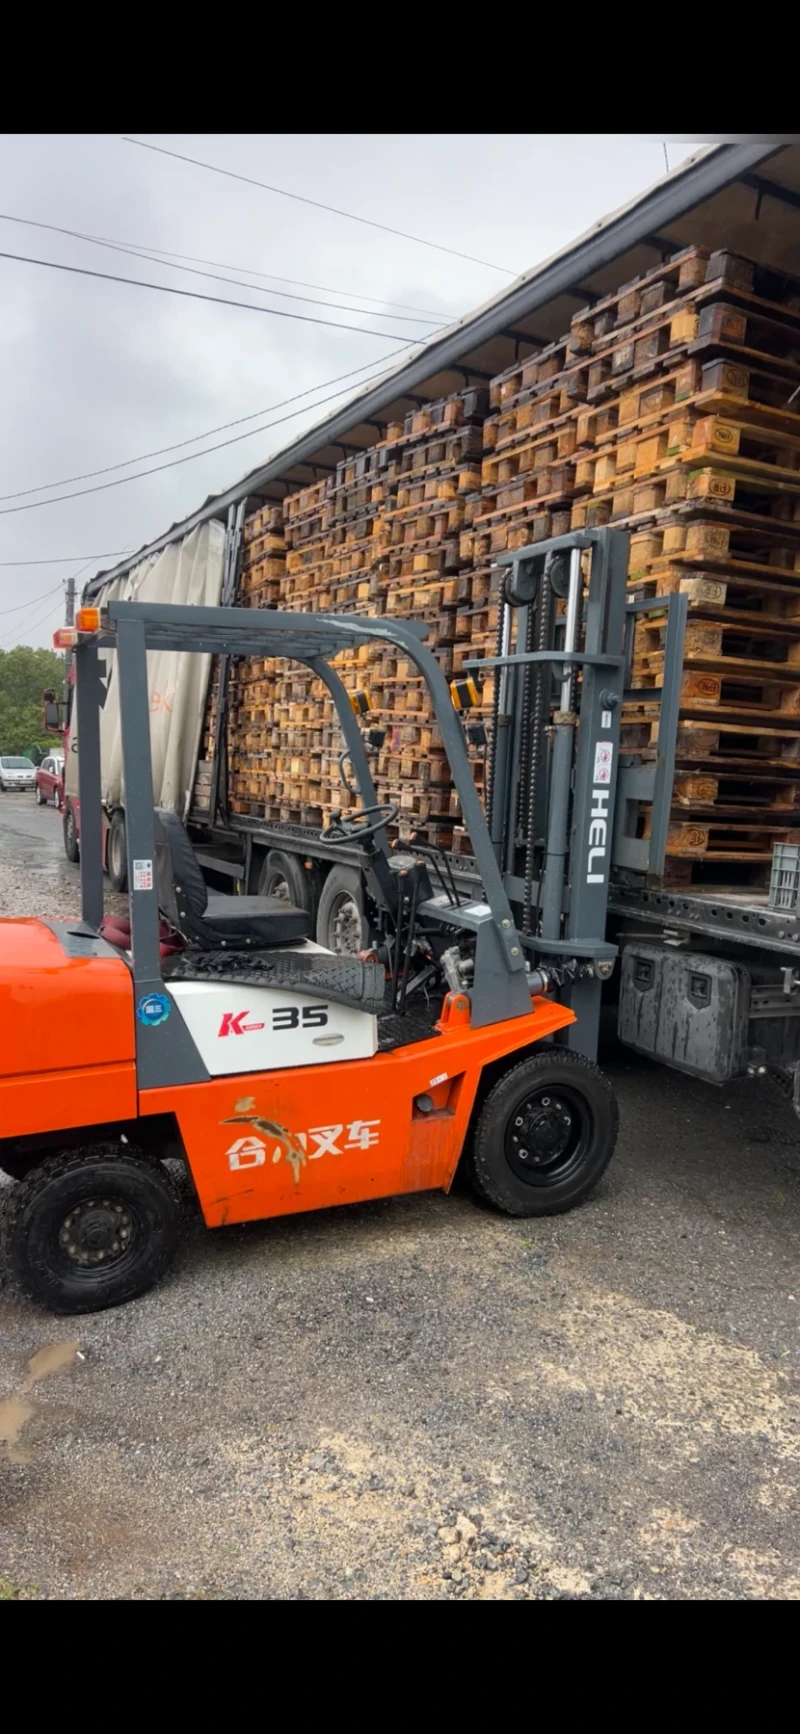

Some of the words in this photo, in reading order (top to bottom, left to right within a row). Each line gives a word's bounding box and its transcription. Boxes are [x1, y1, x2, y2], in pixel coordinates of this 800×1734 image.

[587, 789, 609, 883] HELI
[218, 1011, 250, 1037] K
[272, 1005, 328, 1031] 35
